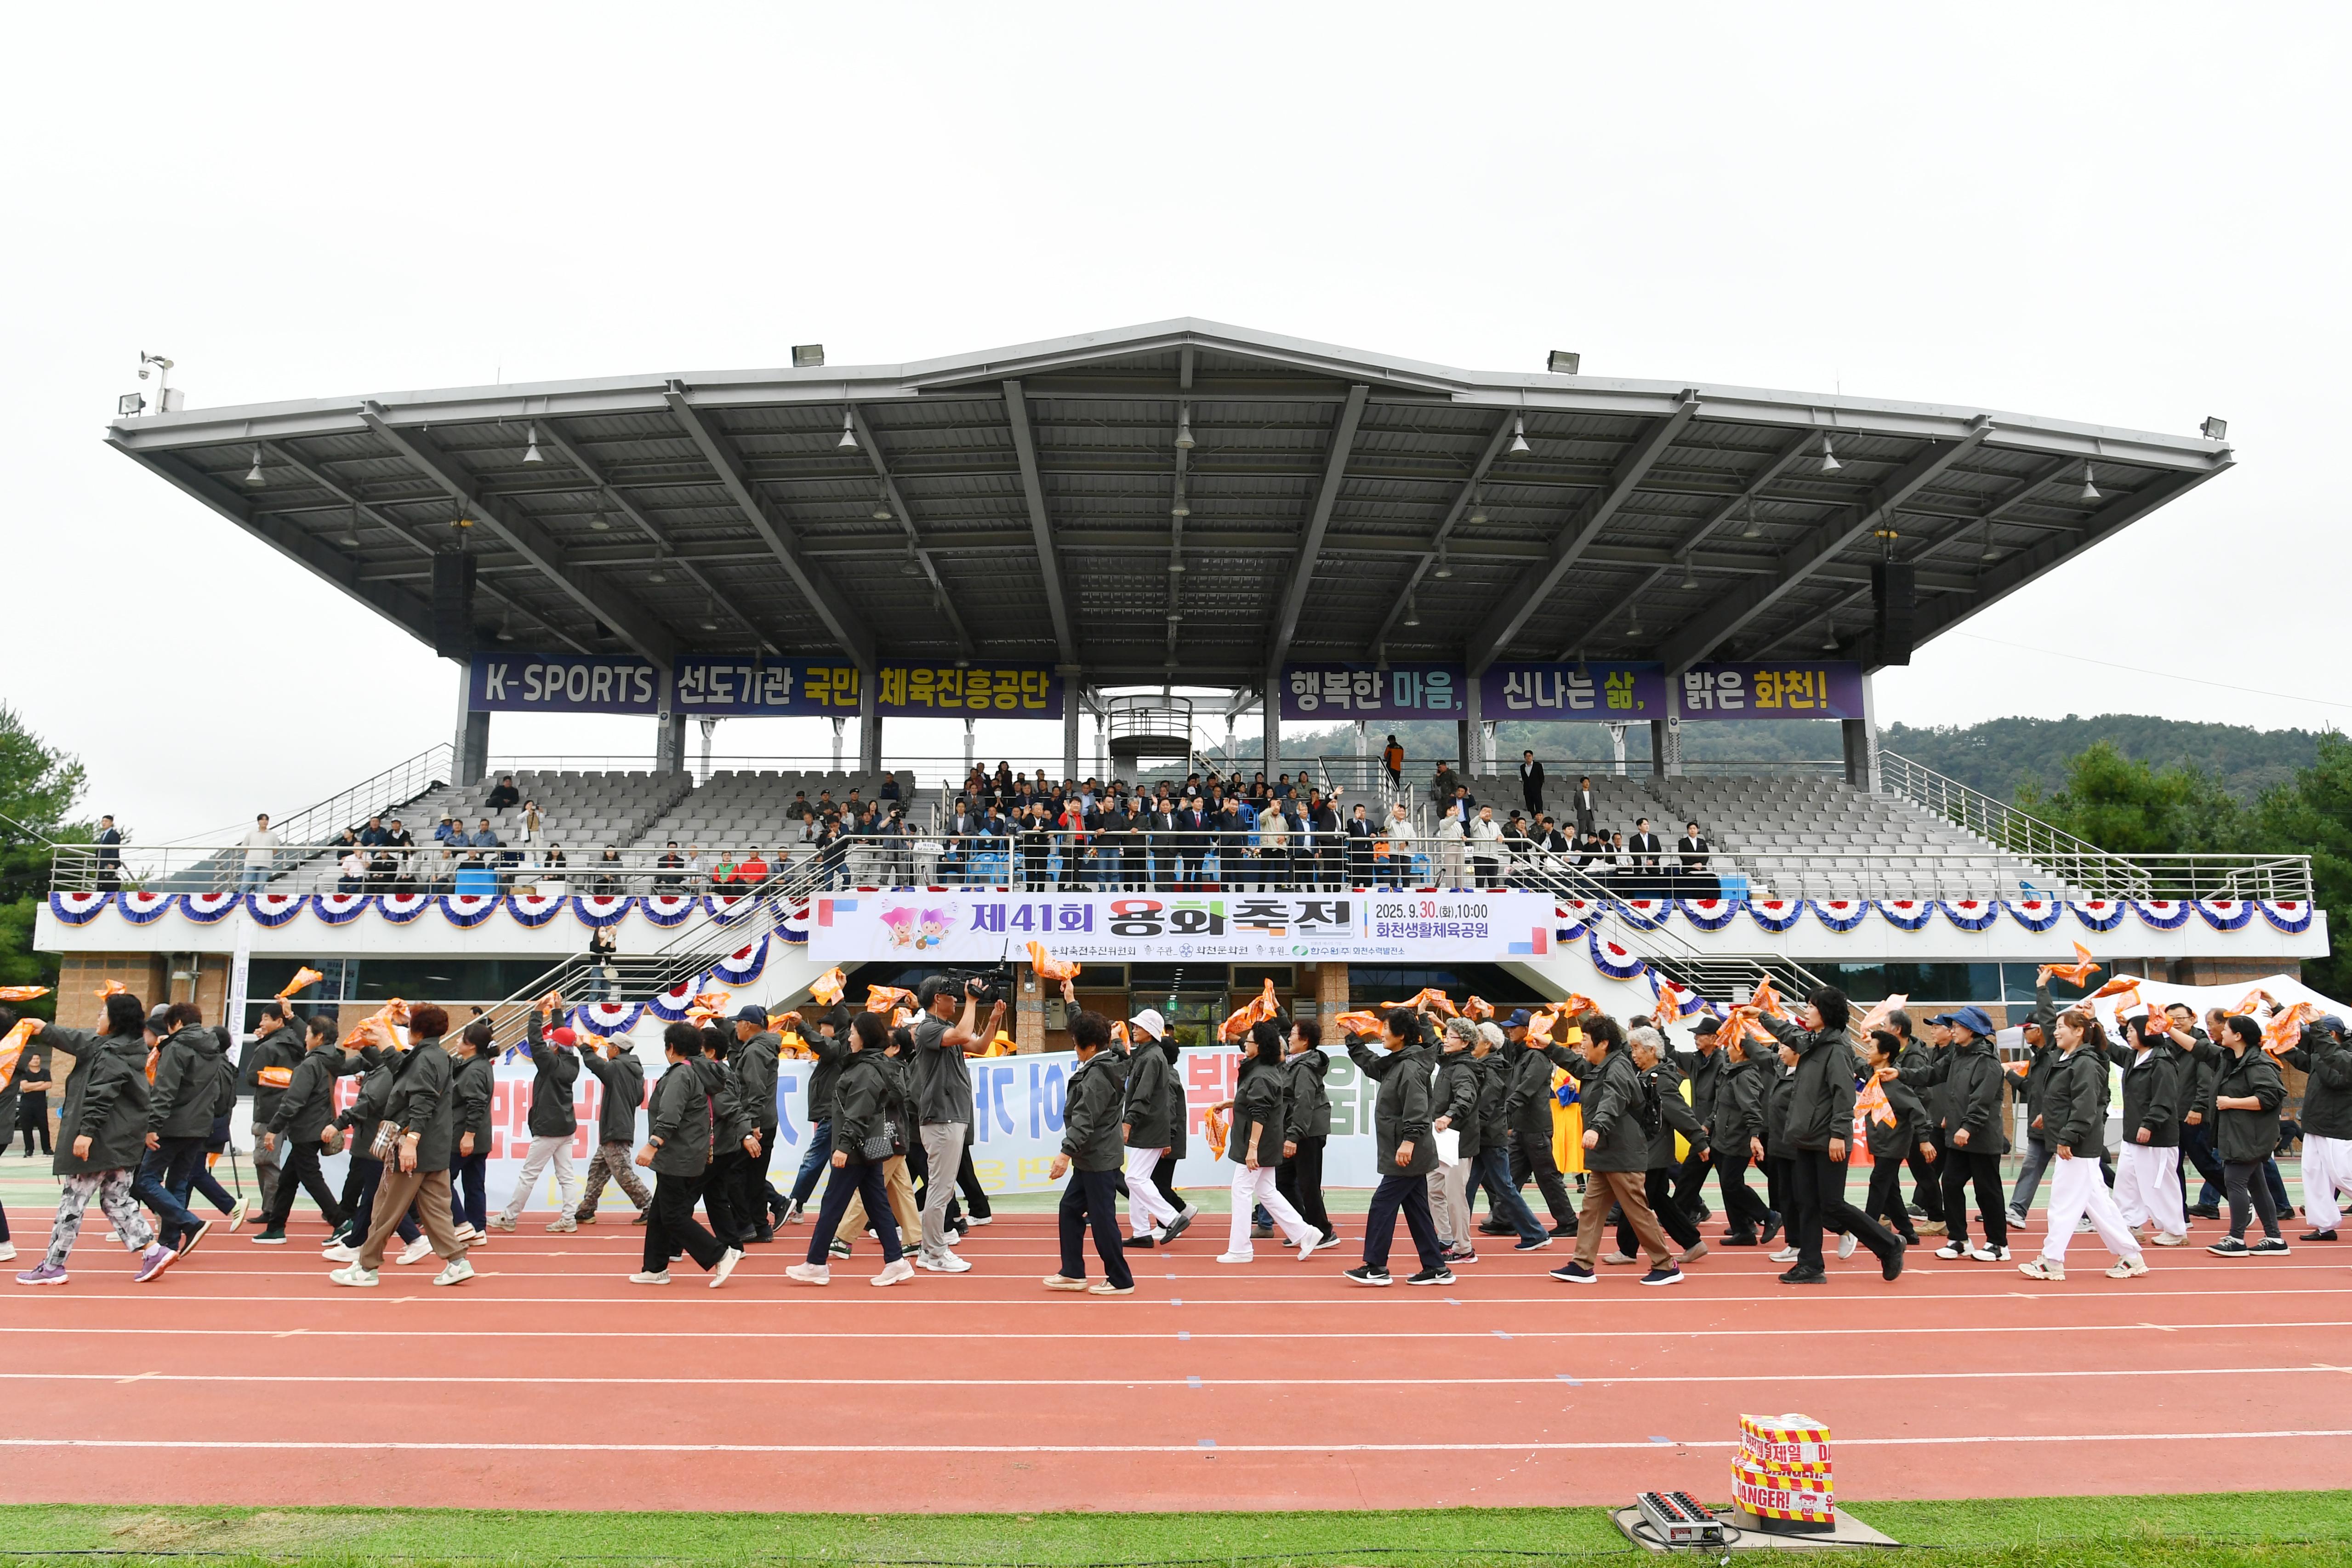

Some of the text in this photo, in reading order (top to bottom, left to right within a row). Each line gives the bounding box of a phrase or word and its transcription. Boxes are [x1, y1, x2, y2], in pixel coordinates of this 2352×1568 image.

[486, 664, 652, 703] K-SPORTS
[678, 666, 858, 706] 선도기관 국민
[878, 667, 1049, 709] 체육진흥공단
[1291, 671, 1463, 711] 행복한 마음,
[1503, 671, 1644, 710] 신나는 삶,
[1684, 670, 1828, 710] 밝은 화천!
[970, 903, 1093, 932] 제41회
[1376, 922, 1488, 938] 화천생활체육공원
[1050, 946, 1136, 956] 용화축전추진위원회
[1196, 946, 1248, 955] 화천문화원
[1353, 947, 1405, 955] 화천수력발전소
[1737, 1482, 1790, 1510] DANGER!
